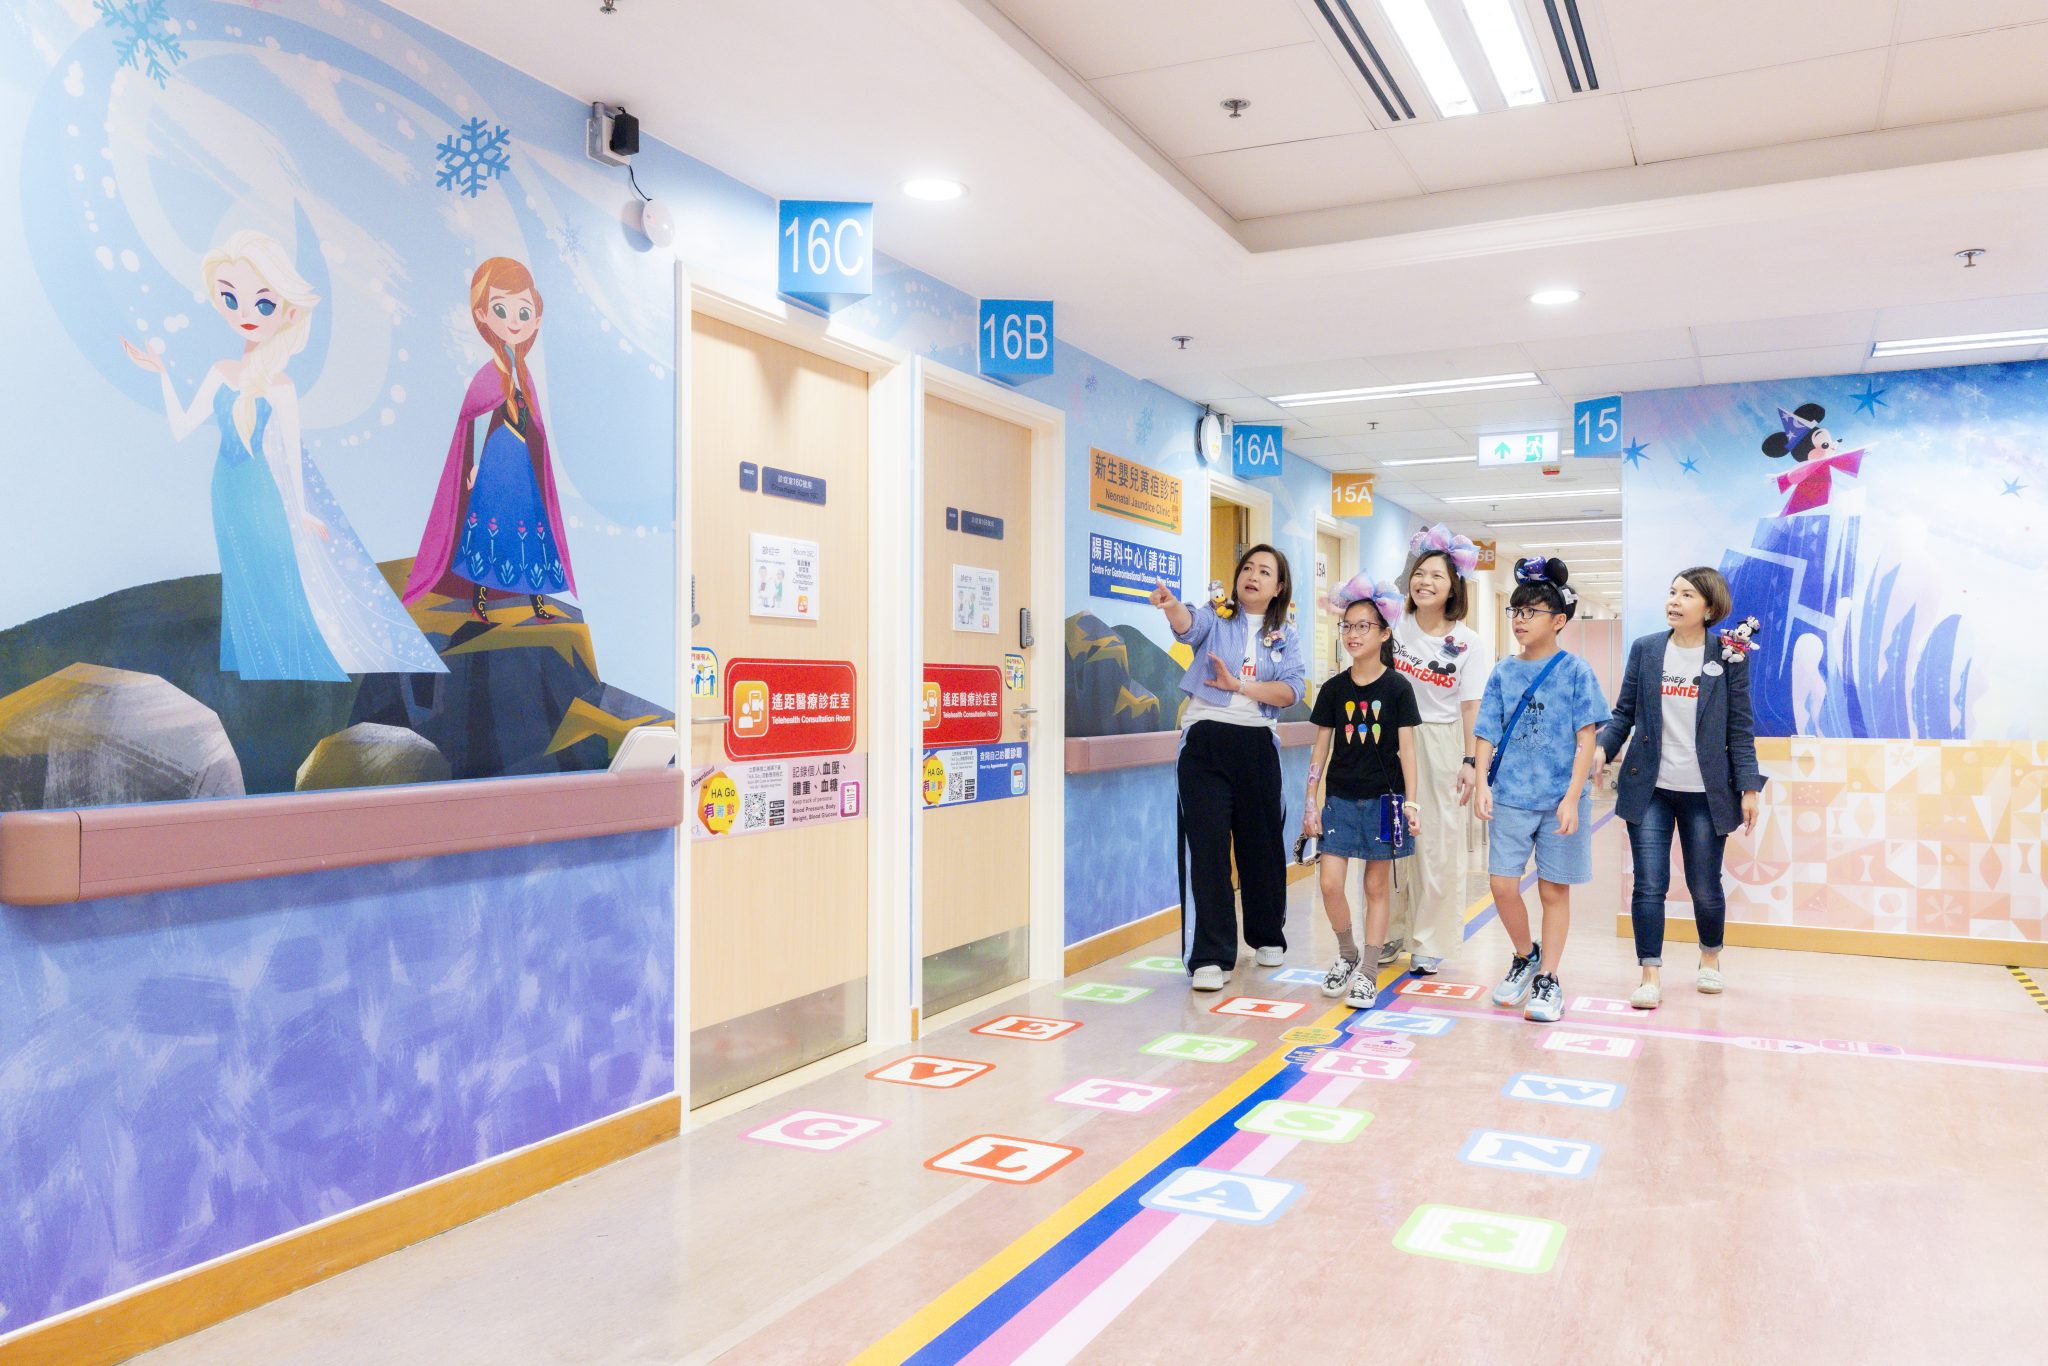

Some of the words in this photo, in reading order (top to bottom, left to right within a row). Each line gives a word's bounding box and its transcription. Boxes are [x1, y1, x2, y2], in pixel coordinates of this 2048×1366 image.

[785, 216, 865, 277] 16C
[983, 313, 1048, 361] 16B
[1577, 406, 1618, 446] 15
[1234, 433, 1279, 466] 16A
[1095, 453, 1179, 505] 新生嬰兒黃疸診所
[1105, 488, 1131, 507] Neonatal
[1131, 495, 1156, 514] Jaundice
[1156, 503, 1171, 518] Clinic
[1332, 485, 1372, 504] 15A
[1091, 536, 1181, 577] 腸胃科中心(請往前)
[1478, 549, 1495, 562] 5B
[1104, 565, 1112, 577] For
[771, 692, 850, 711] 遙距醫療診症室
[771, 715, 801, 725] Telehealth
[801, 714, 835, 724] Consultation
[835, 714, 851, 722] Room
[927, 769, 935, 777] HA
[936, 768, 944, 776] Go
[711, 788, 723, 799] HA
[724, 787, 736, 797] Go
[1414, 983, 1466, 998] H
[1239, 1003, 1279, 1014] I
[995, 1018, 1059, 1036] E
[1371, 1014, 1432, 1029] Z
[1169, 1038, 1234, 1056] F
[1563, 1038, 1612, 1054] 4
[908, 1061, 976, 1084] V
[1325, 1055, 1393, 1078] R
[1081, 1081, 1154, 1106] T
[1521, 1079, 1605, 1101] W
[780, 1118, 860, 1141] G
[1274, 1110, 1342, 1131] S
[960, 1144, 1028, 1174] L
[1488, 1137, 1583, 1168] N
[1168, 1179, 1262, 1214] A
[1439, 1220, 1520, 1254] 8
